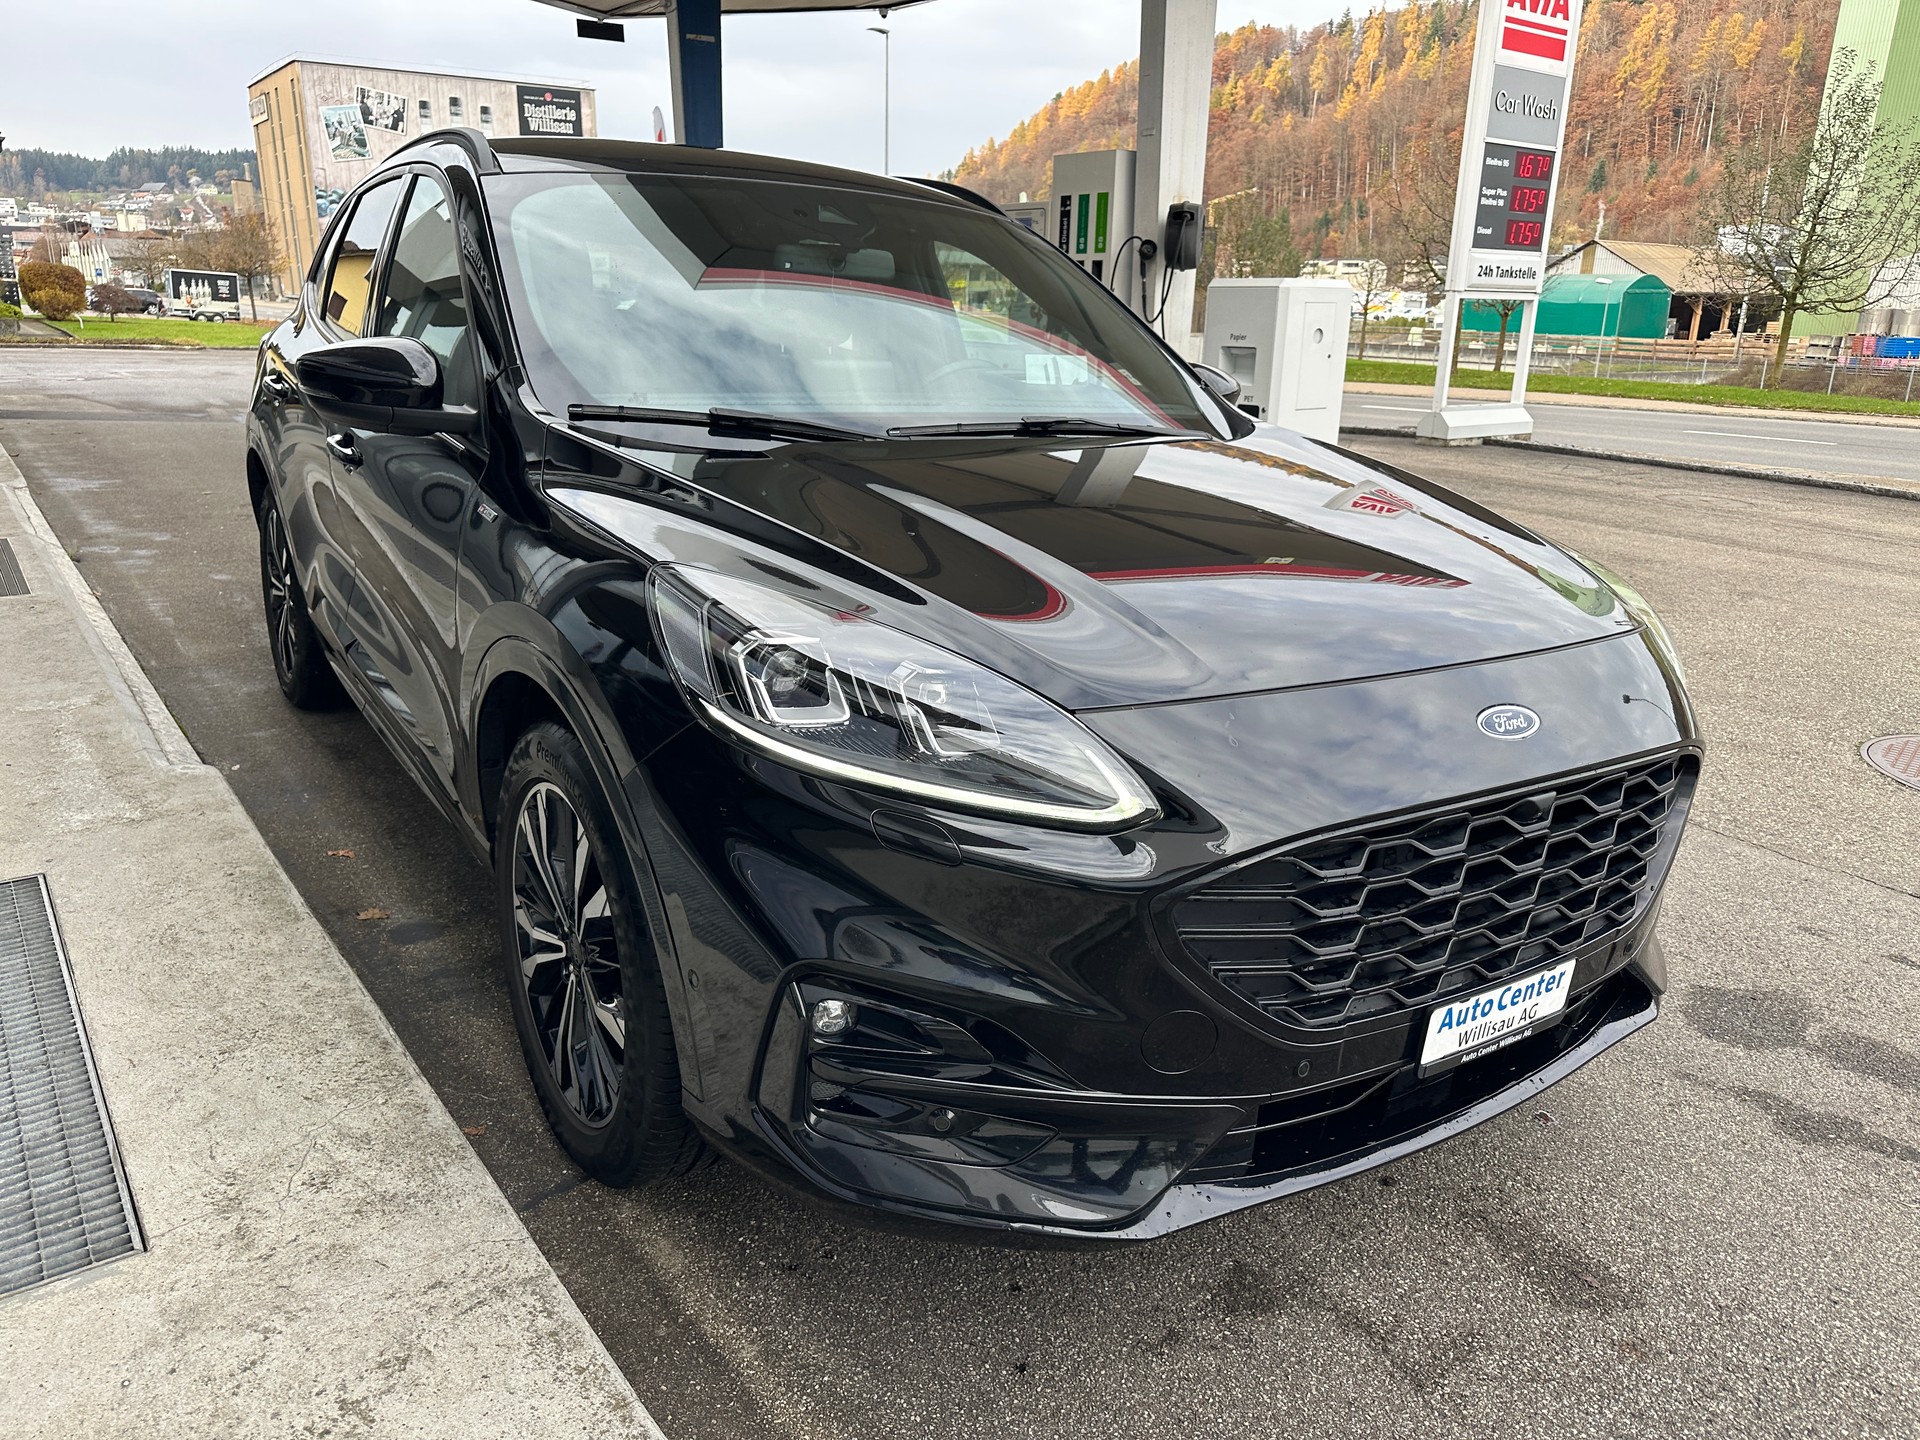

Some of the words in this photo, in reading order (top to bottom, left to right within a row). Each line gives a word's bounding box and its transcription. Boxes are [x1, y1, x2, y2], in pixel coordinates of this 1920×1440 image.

[523, 103, 577, 121] Distillerie
[1495, 90, 1520, 114] Car
[1523, 94, 1558, 120] Wash
[527, 117, 574, 134] Willisau
[1485, 156, 1503, 167] Bleifrei
[1503, 159, 1510, 167] 95
[1481, 186, 1497, 196] Super
[1496, 188, 1508, 197] Plus
[1480, 197, 1497, 206] Bleifrei
[1476, 226, 1493, 235] Diesel
[1477, 265, 1494, 278] 24h
[1495, 265, 1537, 280] Tankstelle
[1229, 333, 1247, 342] Papier
[1243, 395, 1254, 403] PET
[1492, 711, 1528, 733] Ford
[1436, 997, 1495, 1034] Auto
[1496, 970, 1567, 1011] Center
[1457, 1015, 1516, 1048] Willisau
[1517, 1003, 1540, 1025] AG
[1460, 1052, 1478, 1063] Auto
[1478, 1042, 1499, 1057] Center
[1499, 1033, 1522, 1048] Willisau
[1522, 1027, 1533, 1037] AG
